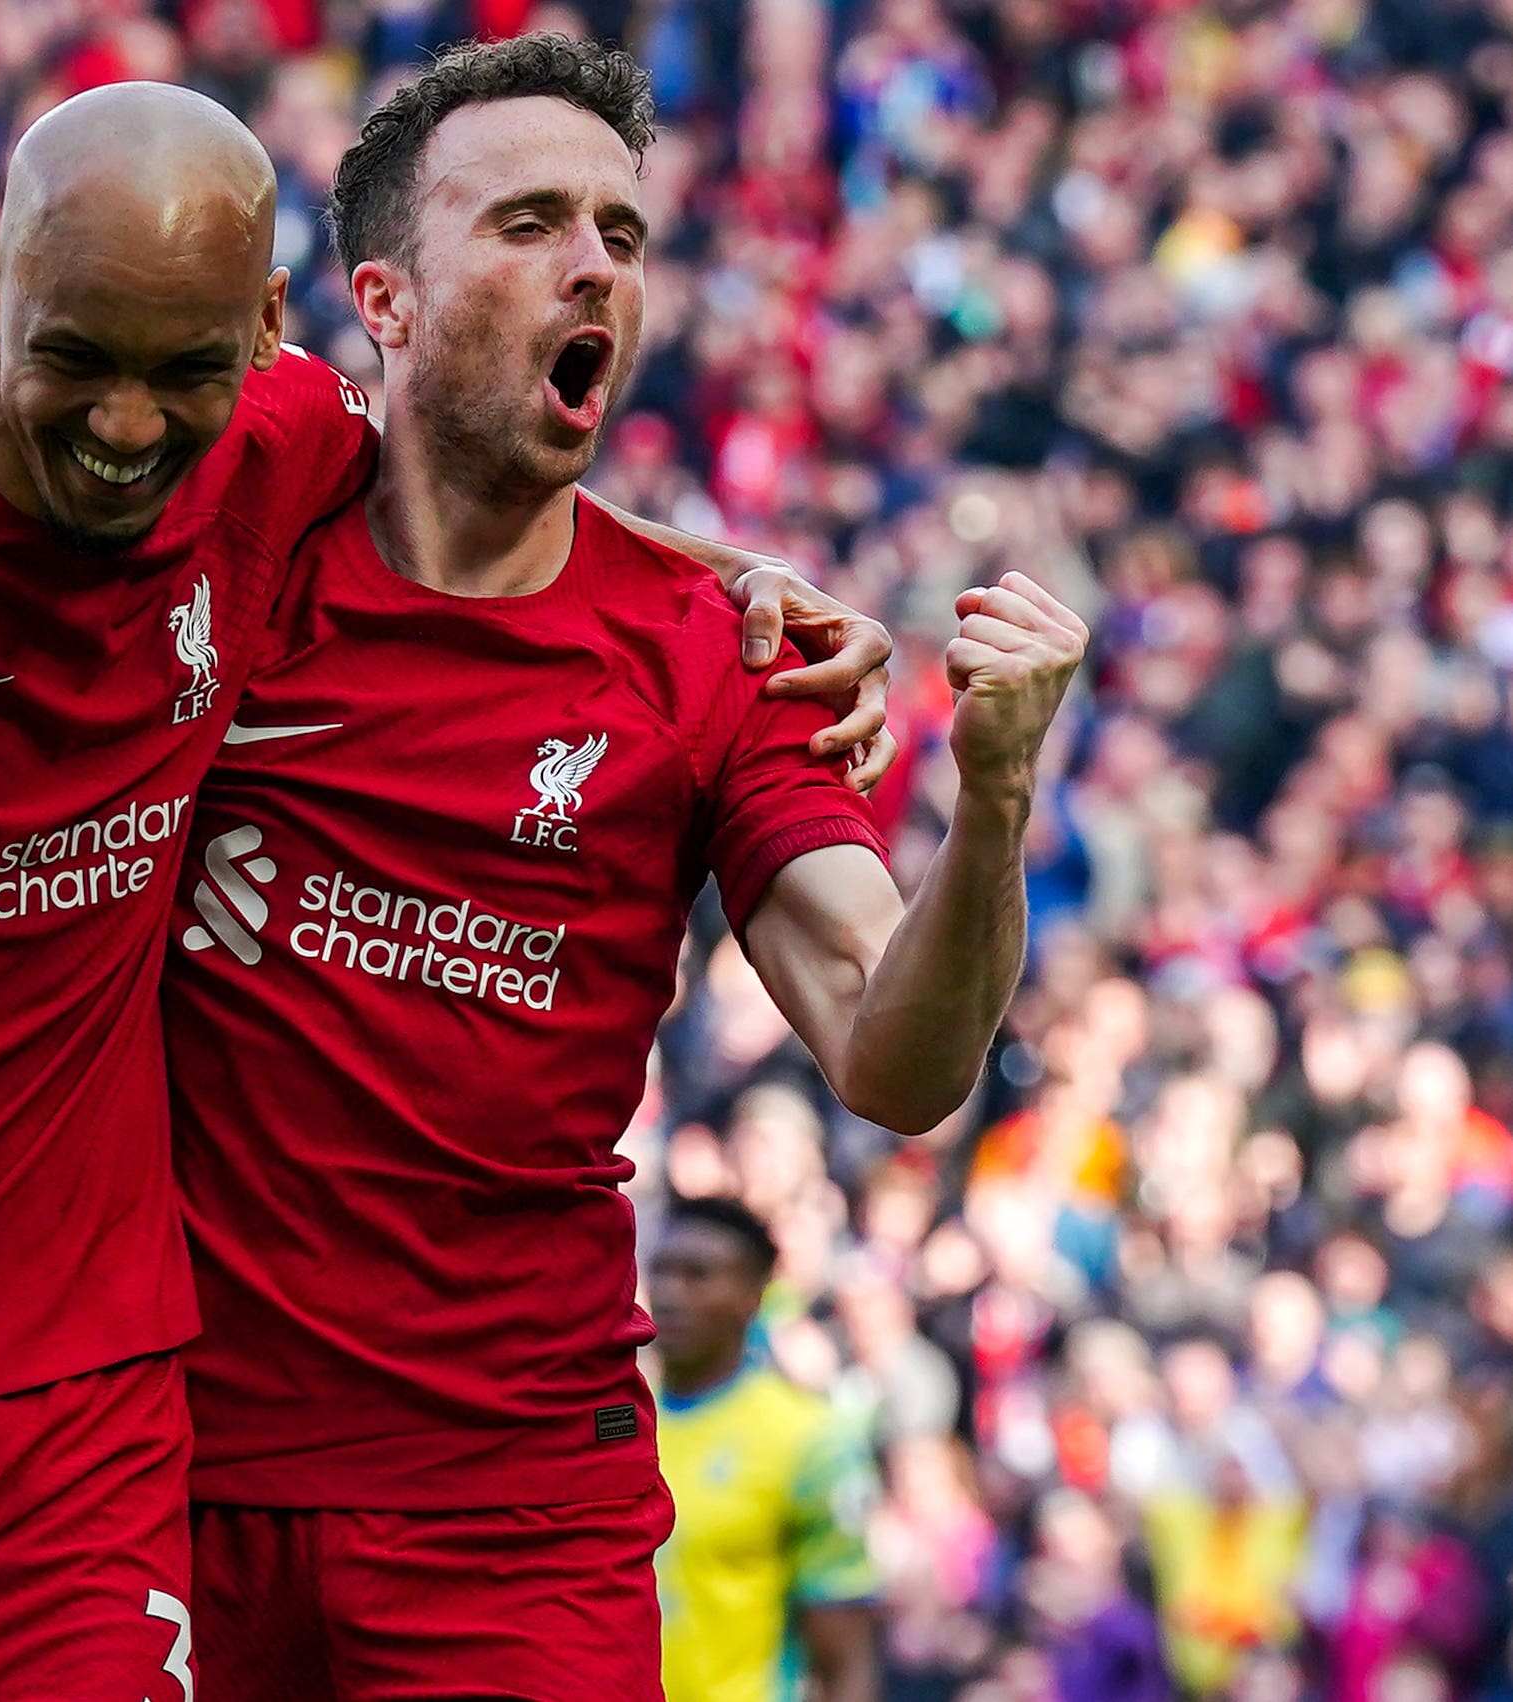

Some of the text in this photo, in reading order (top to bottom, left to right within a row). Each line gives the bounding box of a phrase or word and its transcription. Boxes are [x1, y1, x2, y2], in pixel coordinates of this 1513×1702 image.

[510, 815, 578, 852] L.F.C.
[299, 871, 566, 963] standard
[289, 918, 561, 1012] chartered
